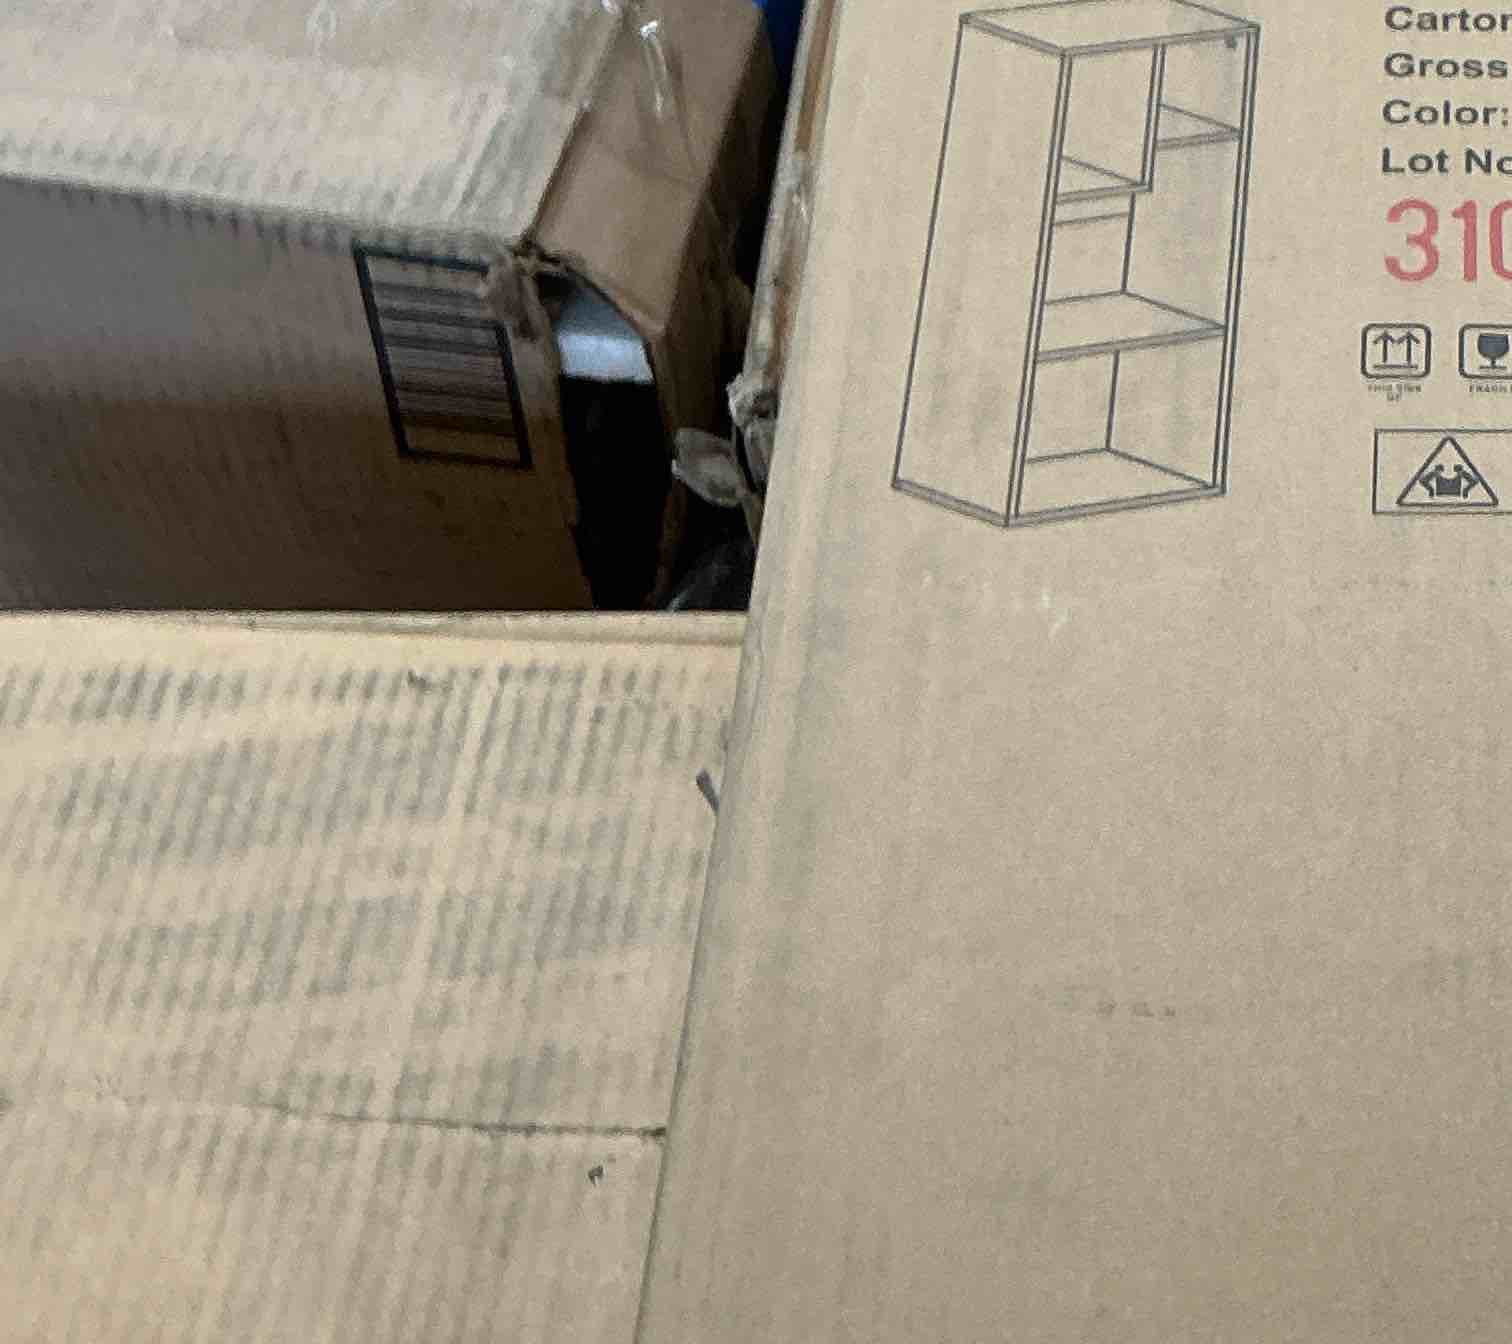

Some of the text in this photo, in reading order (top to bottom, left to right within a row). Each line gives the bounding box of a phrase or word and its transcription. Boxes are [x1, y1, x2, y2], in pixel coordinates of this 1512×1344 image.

[1383, 52, 1508, 79] Gross
[1381, 98, 1510, 127] Color:
[1381, 146, 1449, 174] Lot
